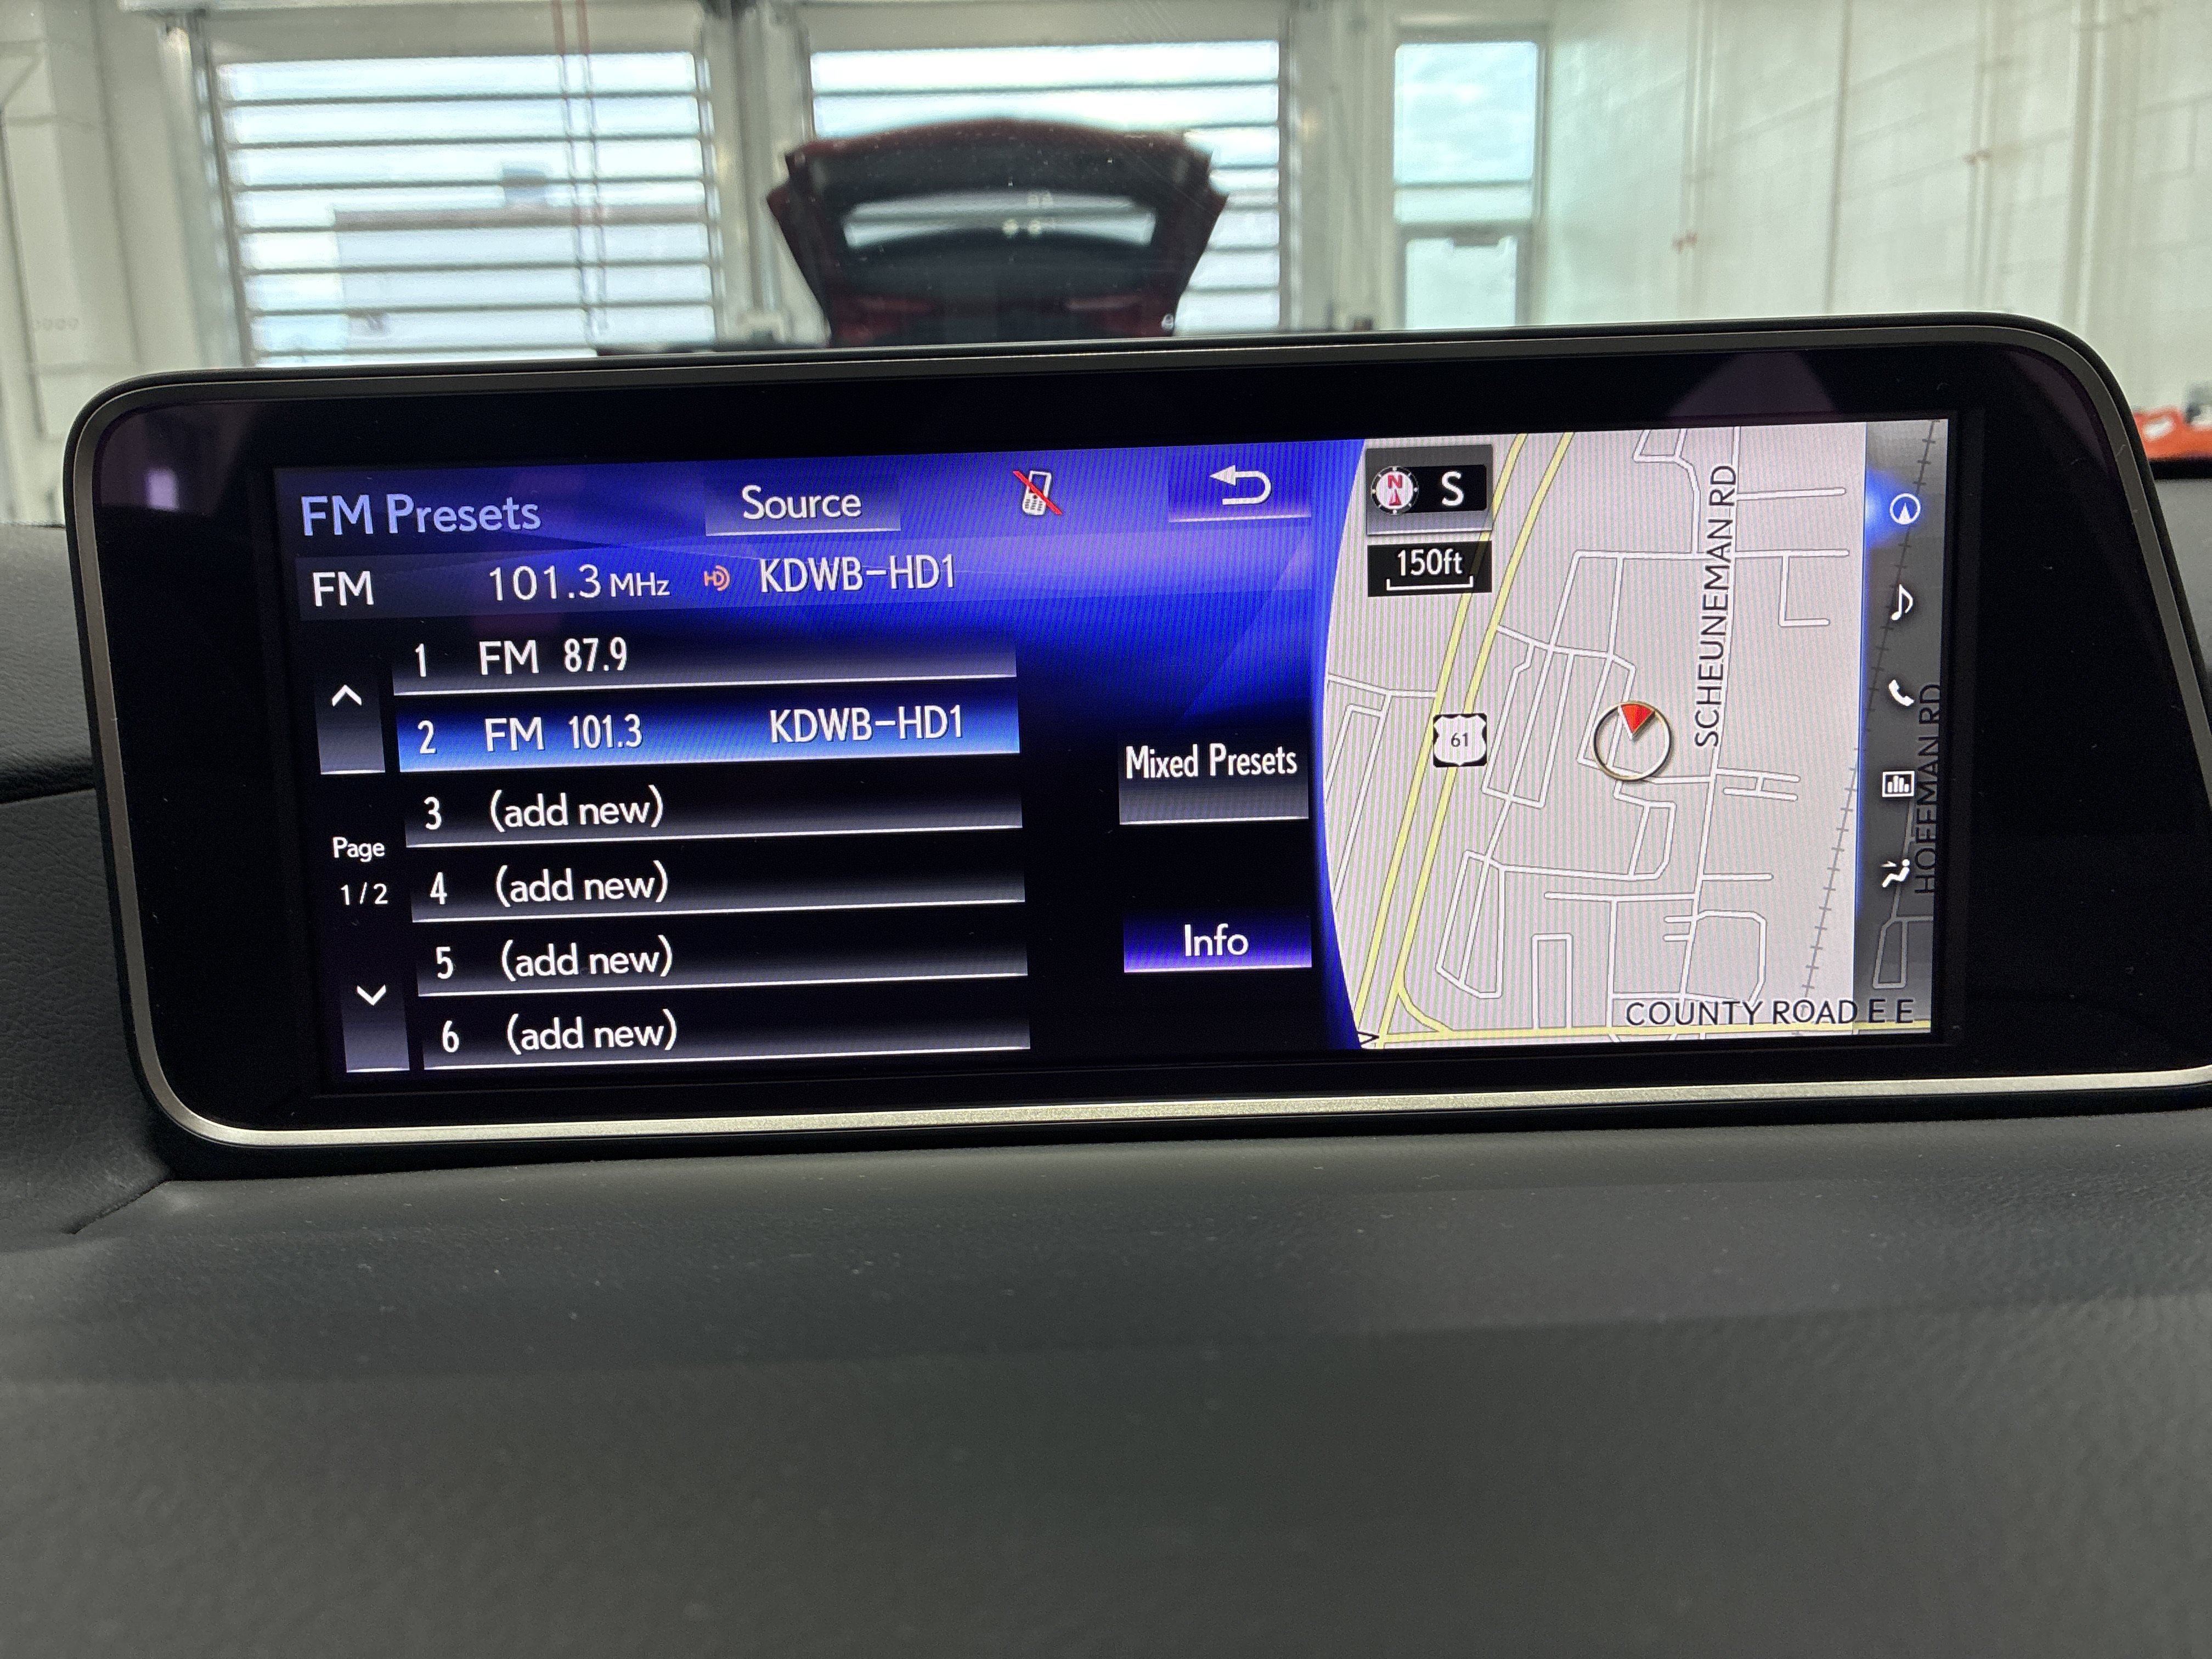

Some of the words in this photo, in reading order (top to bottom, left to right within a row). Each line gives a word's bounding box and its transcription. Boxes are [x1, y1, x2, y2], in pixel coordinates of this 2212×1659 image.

[1387, 473, 1403, 488] N
[1441, 470, 1465, 507] S
[1709, 465, 1736, 506] RD
[301, 495, 374, 536] FM
[386, 494, 541, 534] Presets
[742, 484, 862, 520] Source
[760, 554, 956, 593] KDWB-HD1
[1397, 549, 1463, 577] 150ft
[313, 571, 375, 607] FM
[489, 564, 602, 601] 101.3
[610, 572, 671, 597] MHz
[1695, 520, 1734, 747] SCHEUNEMAN
[415, 643, 427, 678] 1
[478, 639, 540, 676] FM
[563, 636, 628, 673] 87.9
[1920, 684, 1941, 724] RD
[417, 720, 437, 754] 2
[484, 716, 544, 752] FM
[568, 714, 643, 749] 101.3
[770, 704, 963, 743] KDWB-HD1
[1451, 732, 1469, 748] 61
[1125, 743, 1199, 779] Mixed
[1209, 743, 1298, 777] Presets
[424, 796, 442, 831] 3
[490, 789, 568, 832] (add
[579, 784, 664, 828] new)
[332, 837, 386, 863] Page
[429, 872, 448, 905] 4
[495, 864, 574, 908] (add
[584, 859, 669, 903] new)
[436, 946, 454, 980] 5
[501, 939, 579, 983] (add
[589, 934, 674, 978] new)
[1184, 923, 1250, 957] Info
[1626, 1001, 1763, 1025] COUNTY
[1773, 999, 1858, 1024] ROAD
[1868, 999, 1886, 1023] E
[1895, 998, 1914, 1022] E
[442, 1020, 460, 1053] 6
[506, 1013, 585, 1056] (add
[594, 1008, 678, 1051] new)
